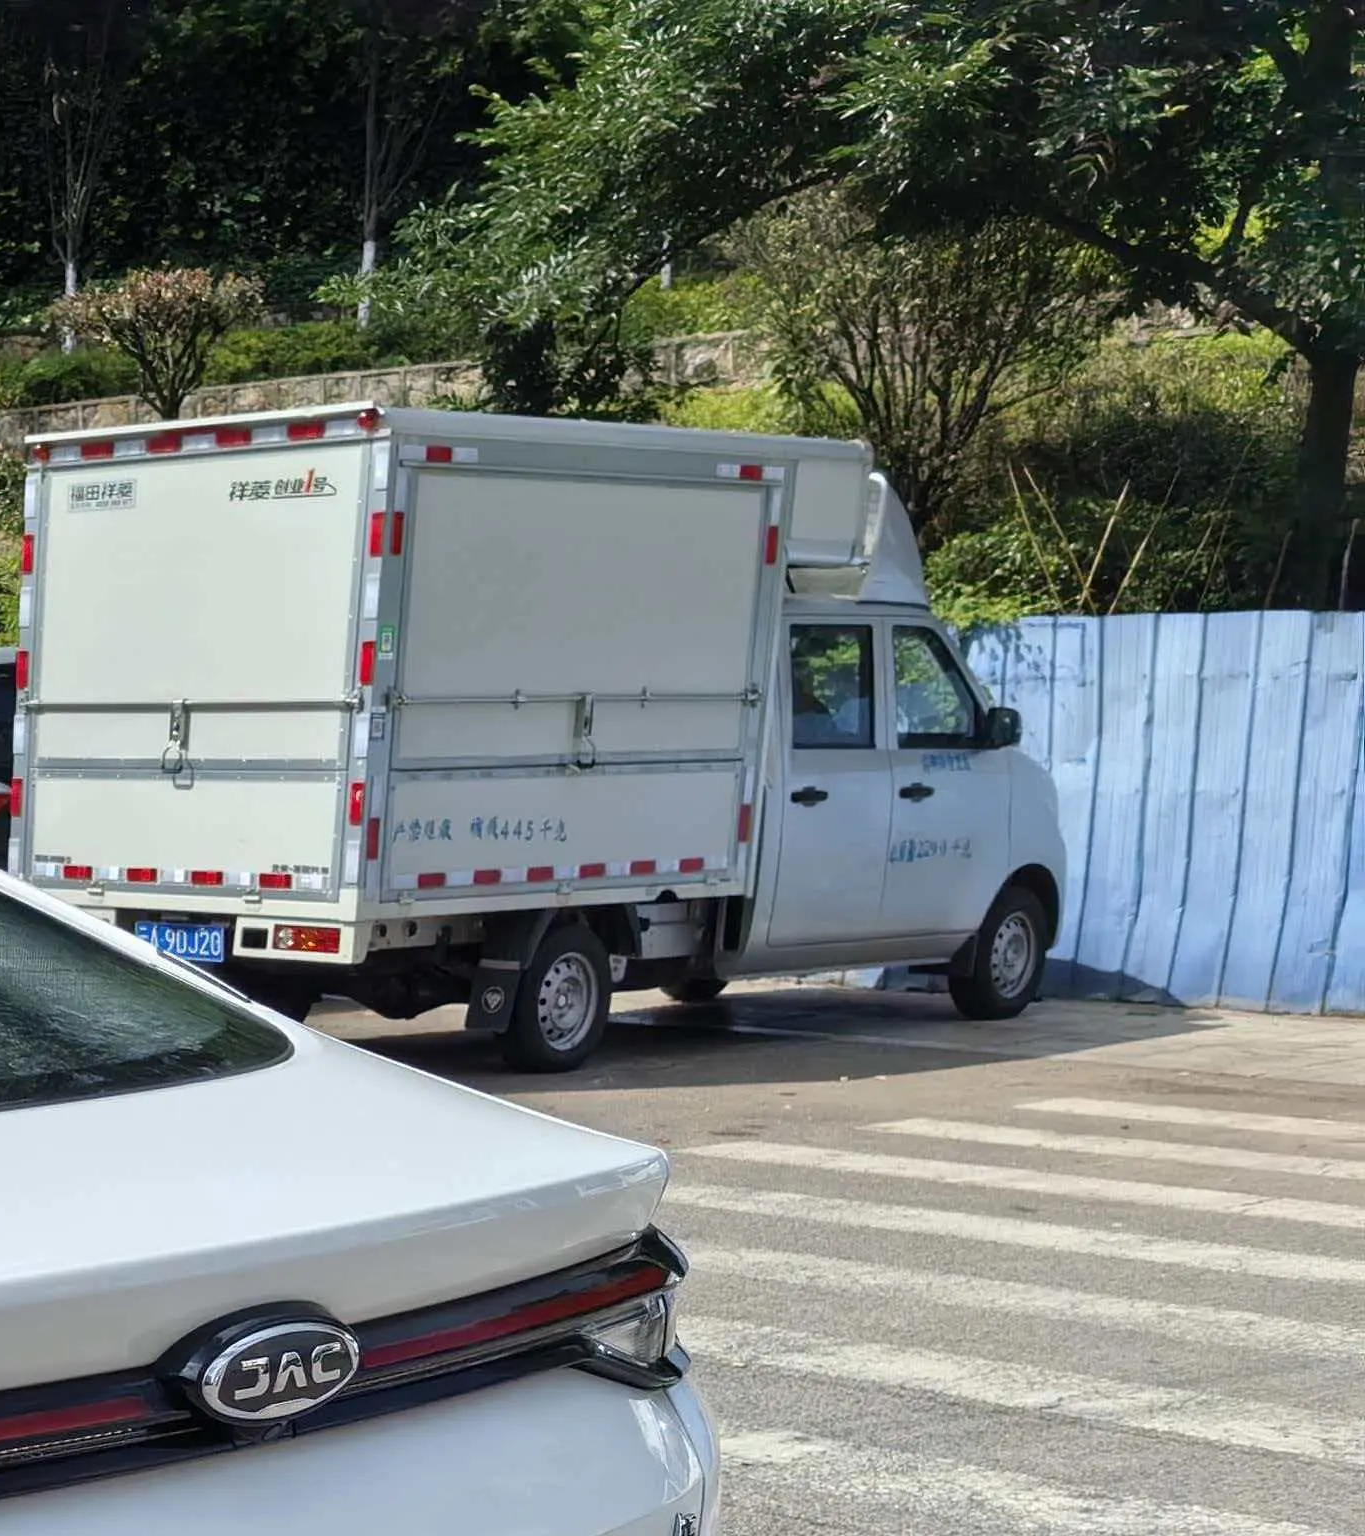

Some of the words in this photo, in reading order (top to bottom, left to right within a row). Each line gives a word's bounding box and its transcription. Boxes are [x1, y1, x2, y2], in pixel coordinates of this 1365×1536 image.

[70, 482, 134, 501] 福田祥菱
[233, 1341, 341, 1399] JAC
